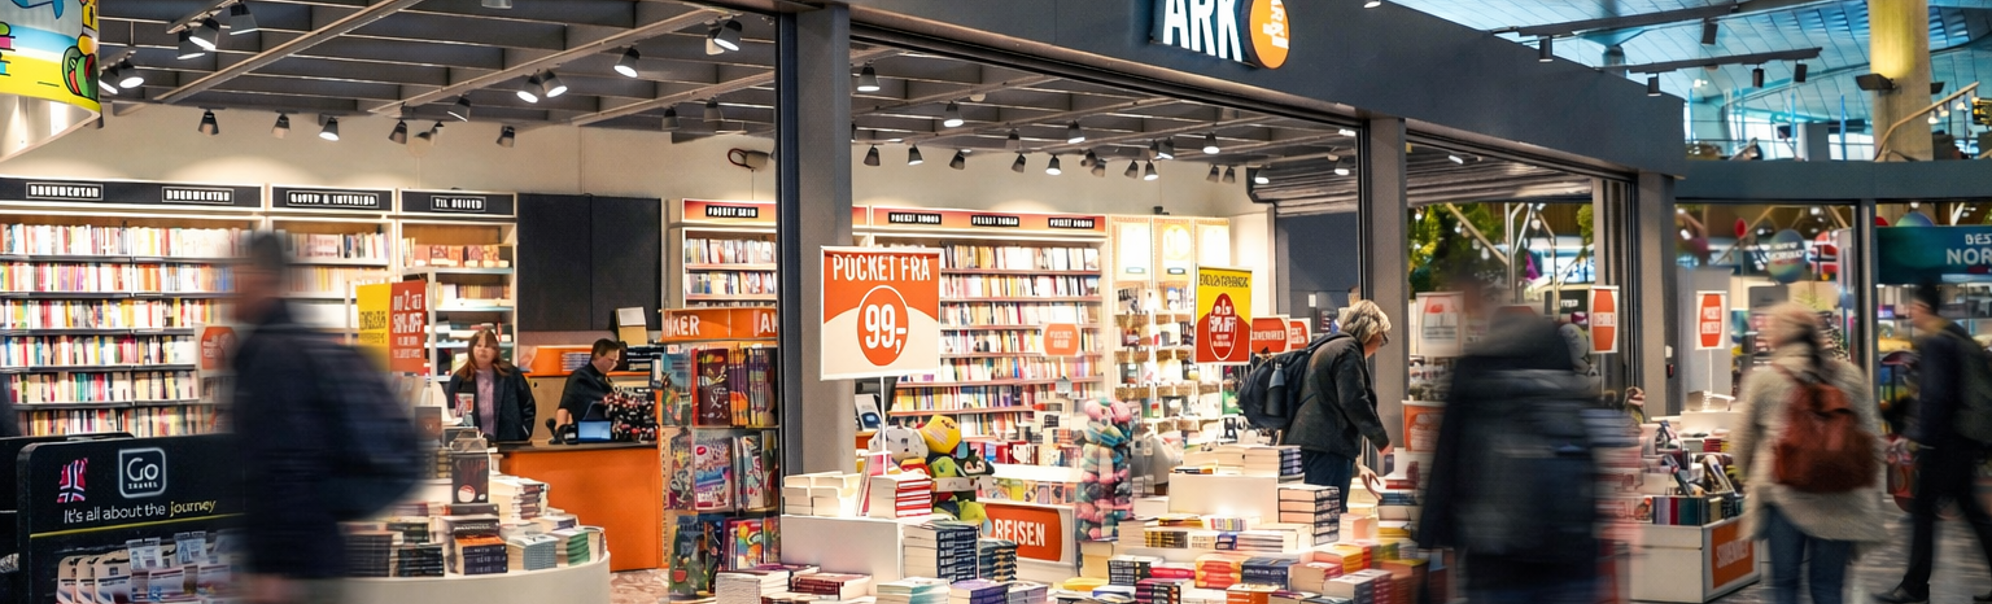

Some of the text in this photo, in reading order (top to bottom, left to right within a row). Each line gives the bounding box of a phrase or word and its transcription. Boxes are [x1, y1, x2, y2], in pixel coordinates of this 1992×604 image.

[1163, 0, 1243, 63] ARK
[833, 253, 931, 282] POCKET FRA
[127, 457, 159, 481] Go
[65, 500, 217, 523] It's all about the journey
